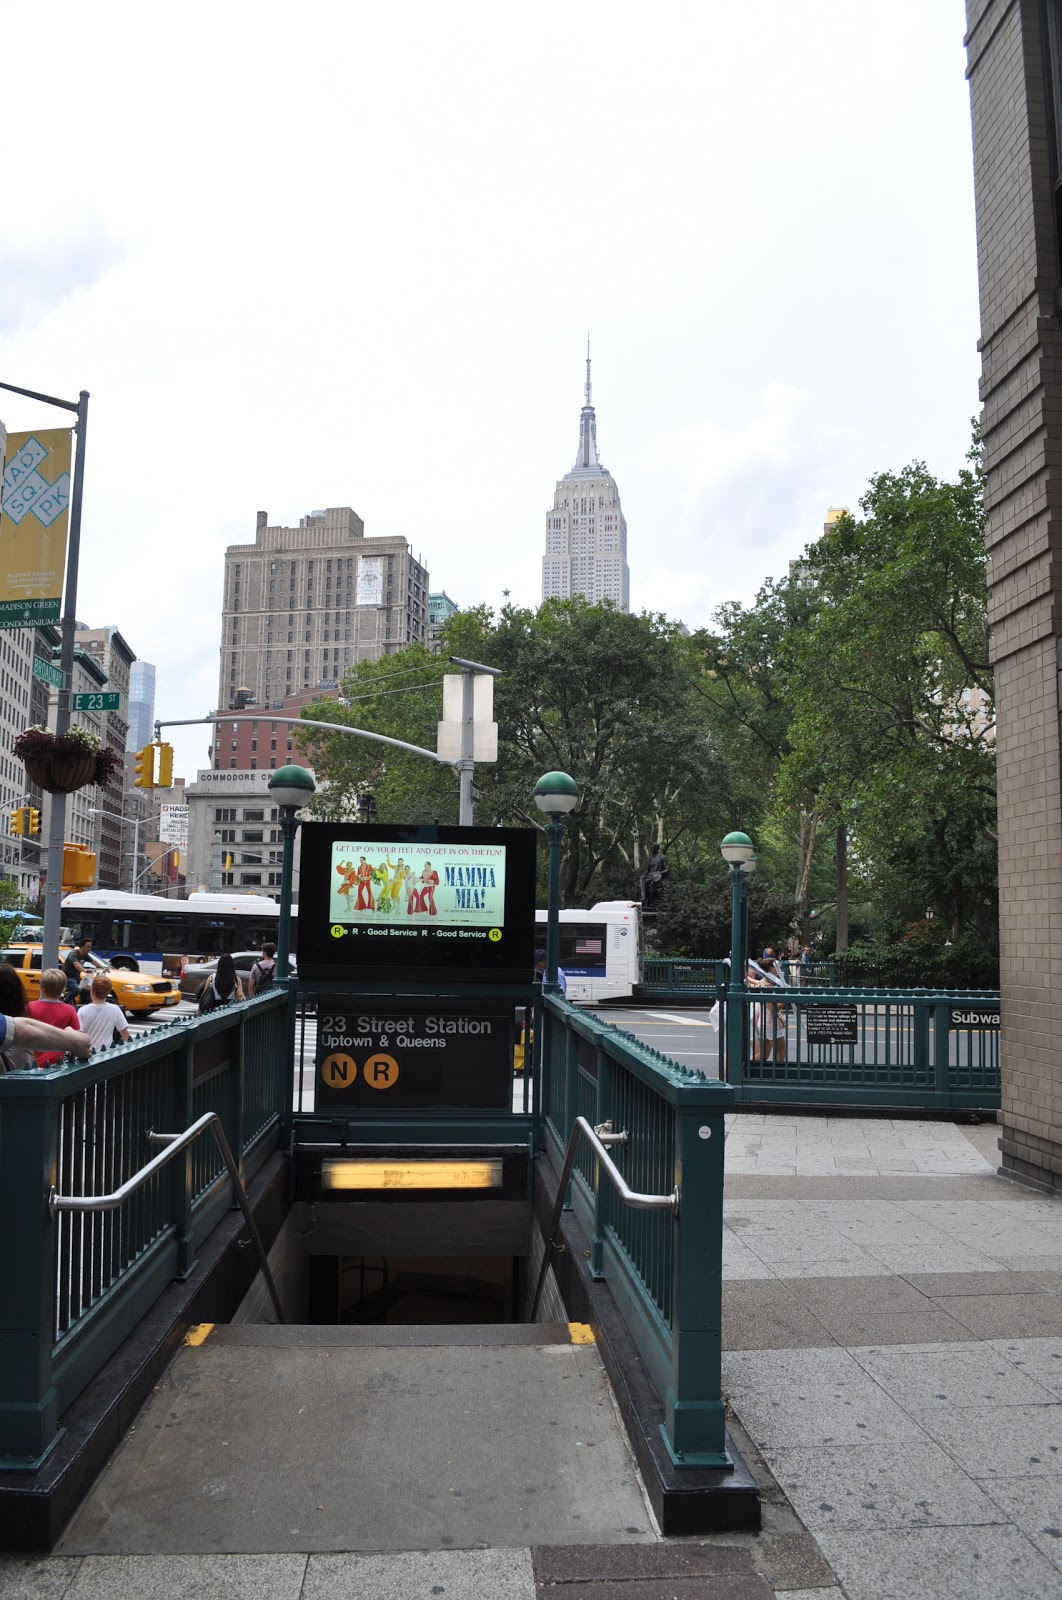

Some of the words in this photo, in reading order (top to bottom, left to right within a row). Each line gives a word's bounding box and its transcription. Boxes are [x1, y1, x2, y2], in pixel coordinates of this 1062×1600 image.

[11, 485, 43, 514] SQ.
[39, 486, 70, 517] PK
[33, 600, 59, 609] GREEN
[34, 658, 63, 688] BROADWAY
[75, 695, 83, 710] E
[88, 694, 104, 709] 23
[108, 694, 117, 703] ST
[201, 773, 256, 781] COMMODORE
[486, 849, 502, 857] FUN!
[444, 866, 496, 888] MAMMA
[454, 888, 486, 909] MIA!
[367, 928, 389, 936] Good
[389, 929, 418, 937] Service
[458, 930, 487, 938] Service
[322, 1016, 347, 1033] 23
[357, 1016, 415, 1034] Street
[425, 1017, 492, 1034] Station
[951, 1010, 1000, 1025] Subwa
[321, 1035, 372, 1048] Uptown
[379, 1035, 389, 1047] &
[396, 1035, 446, 1048] Queens
[330, 1061, 348, 1081] N
[373, 1061, 389, 1081] R
